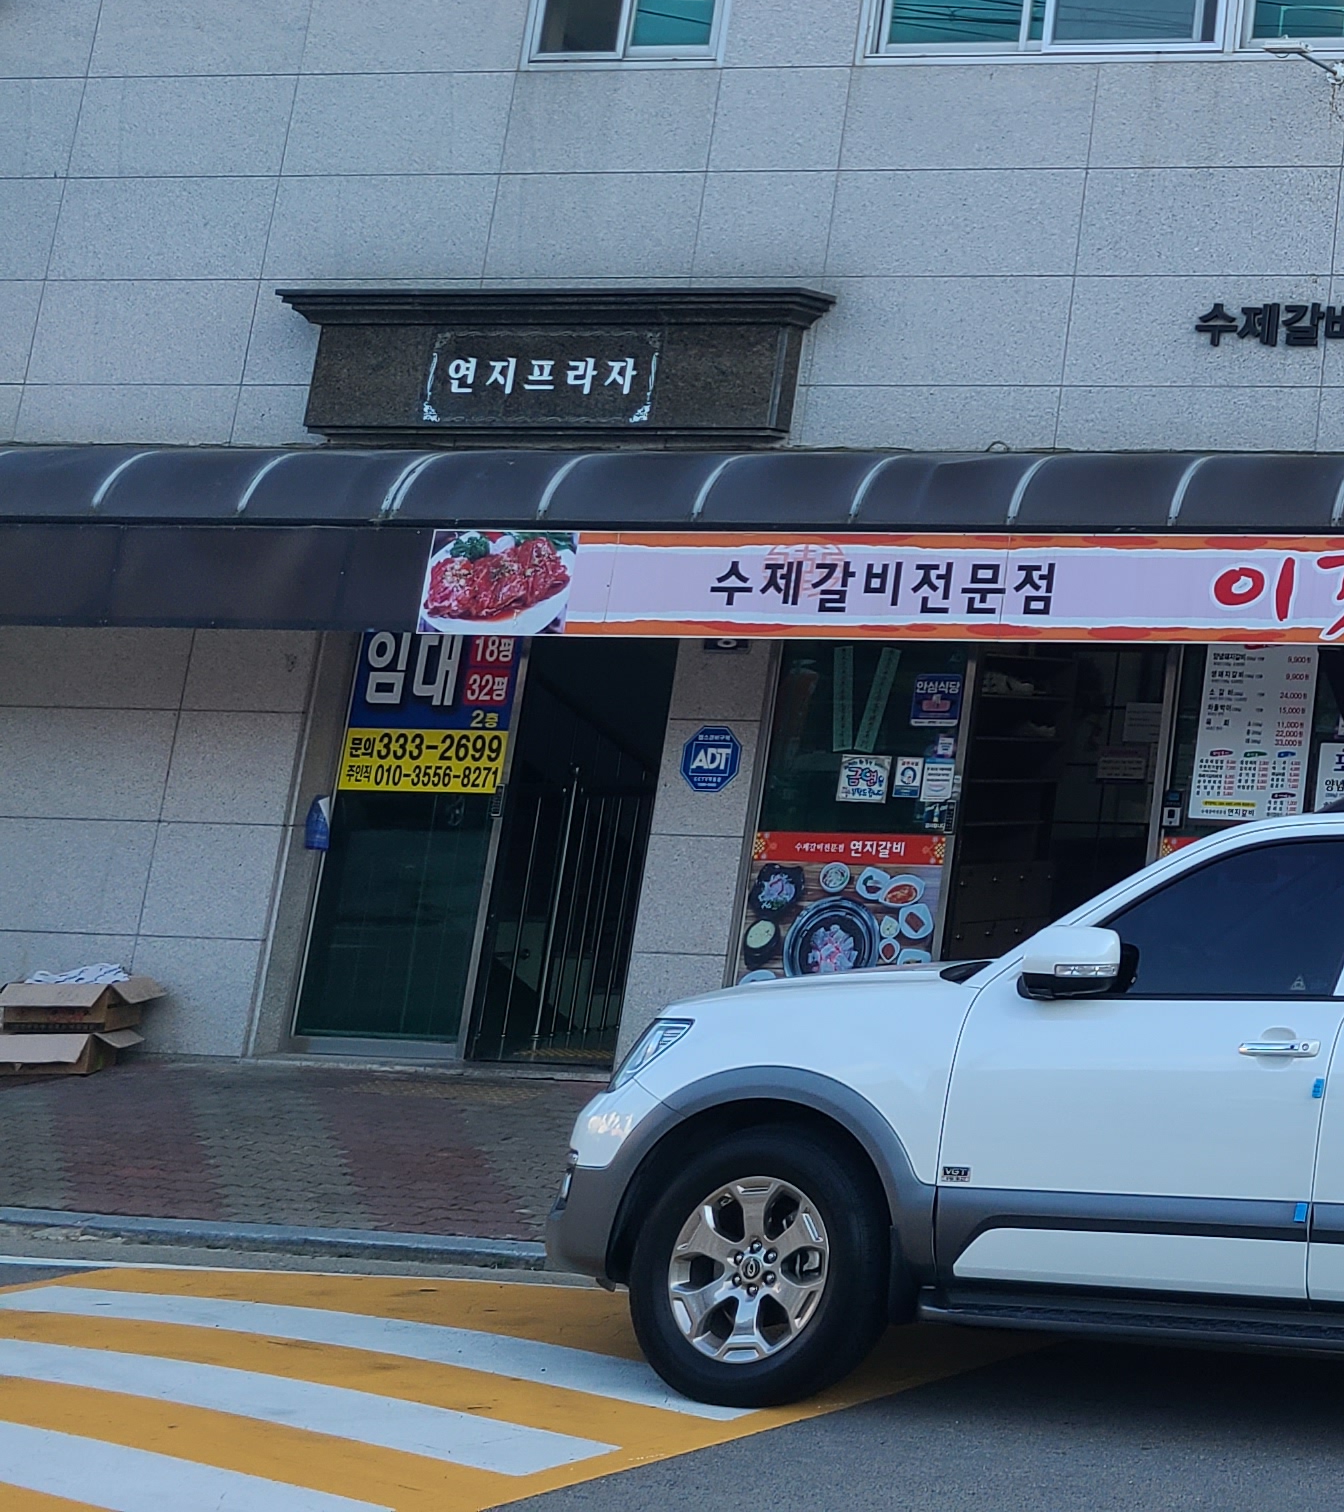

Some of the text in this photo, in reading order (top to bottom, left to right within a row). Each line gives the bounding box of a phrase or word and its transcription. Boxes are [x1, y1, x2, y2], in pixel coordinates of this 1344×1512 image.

[447, 357, 638, 396] 연지프라자
[709, 561, 1058, 617] 수제갈비전문점
[474, 635, 514, 663] 18평
[366, 631, 463, 706] 임대
[466, 673, 508, 702] 32평
[915, 680, 961, 695] 안심식당
[349, 732, 504, 763] 문의 333-2699
[690, 748, 732, 771] ADT
[374, 764, 499, 789] 010-3556-8271
[850, 840, 906, 858] 연지갈비
[945, 1168, 968, 1176] VGT
